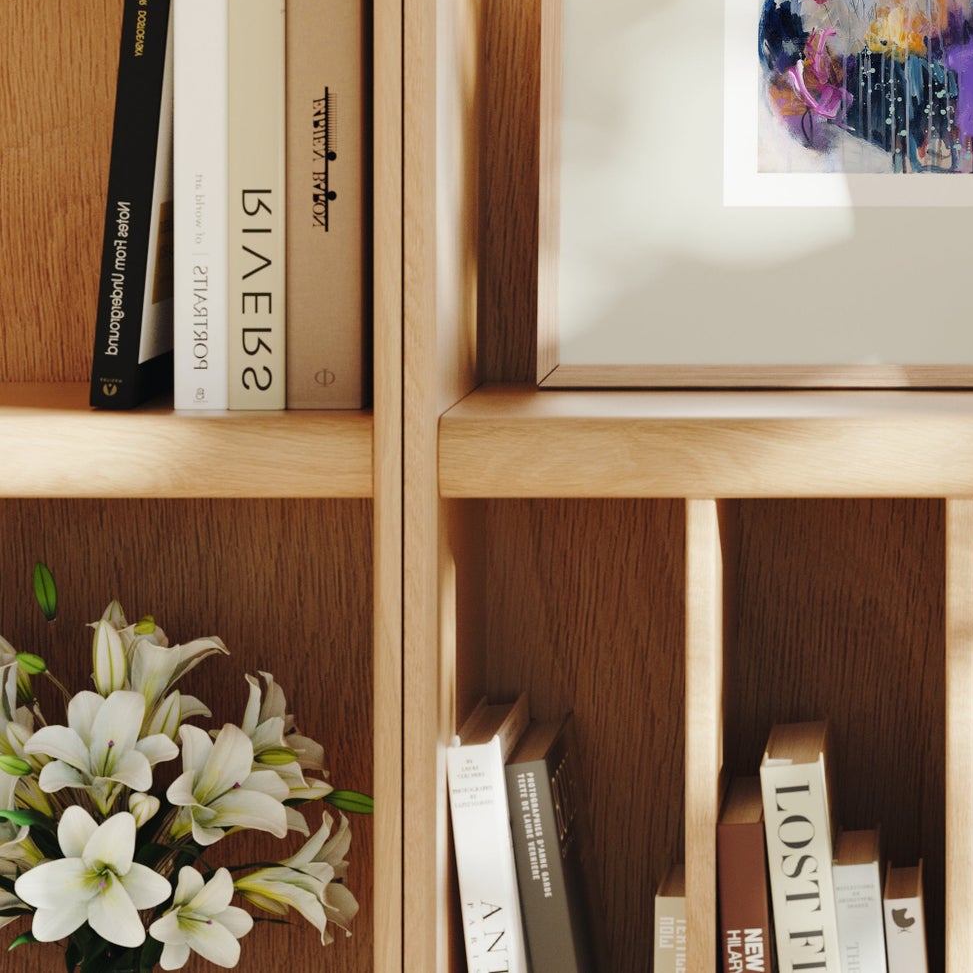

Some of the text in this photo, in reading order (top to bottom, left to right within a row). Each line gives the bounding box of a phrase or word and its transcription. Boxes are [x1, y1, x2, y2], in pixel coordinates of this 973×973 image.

[775, 780, 827, 973] LOST FI
[744, 928, 765, 972] NEW
